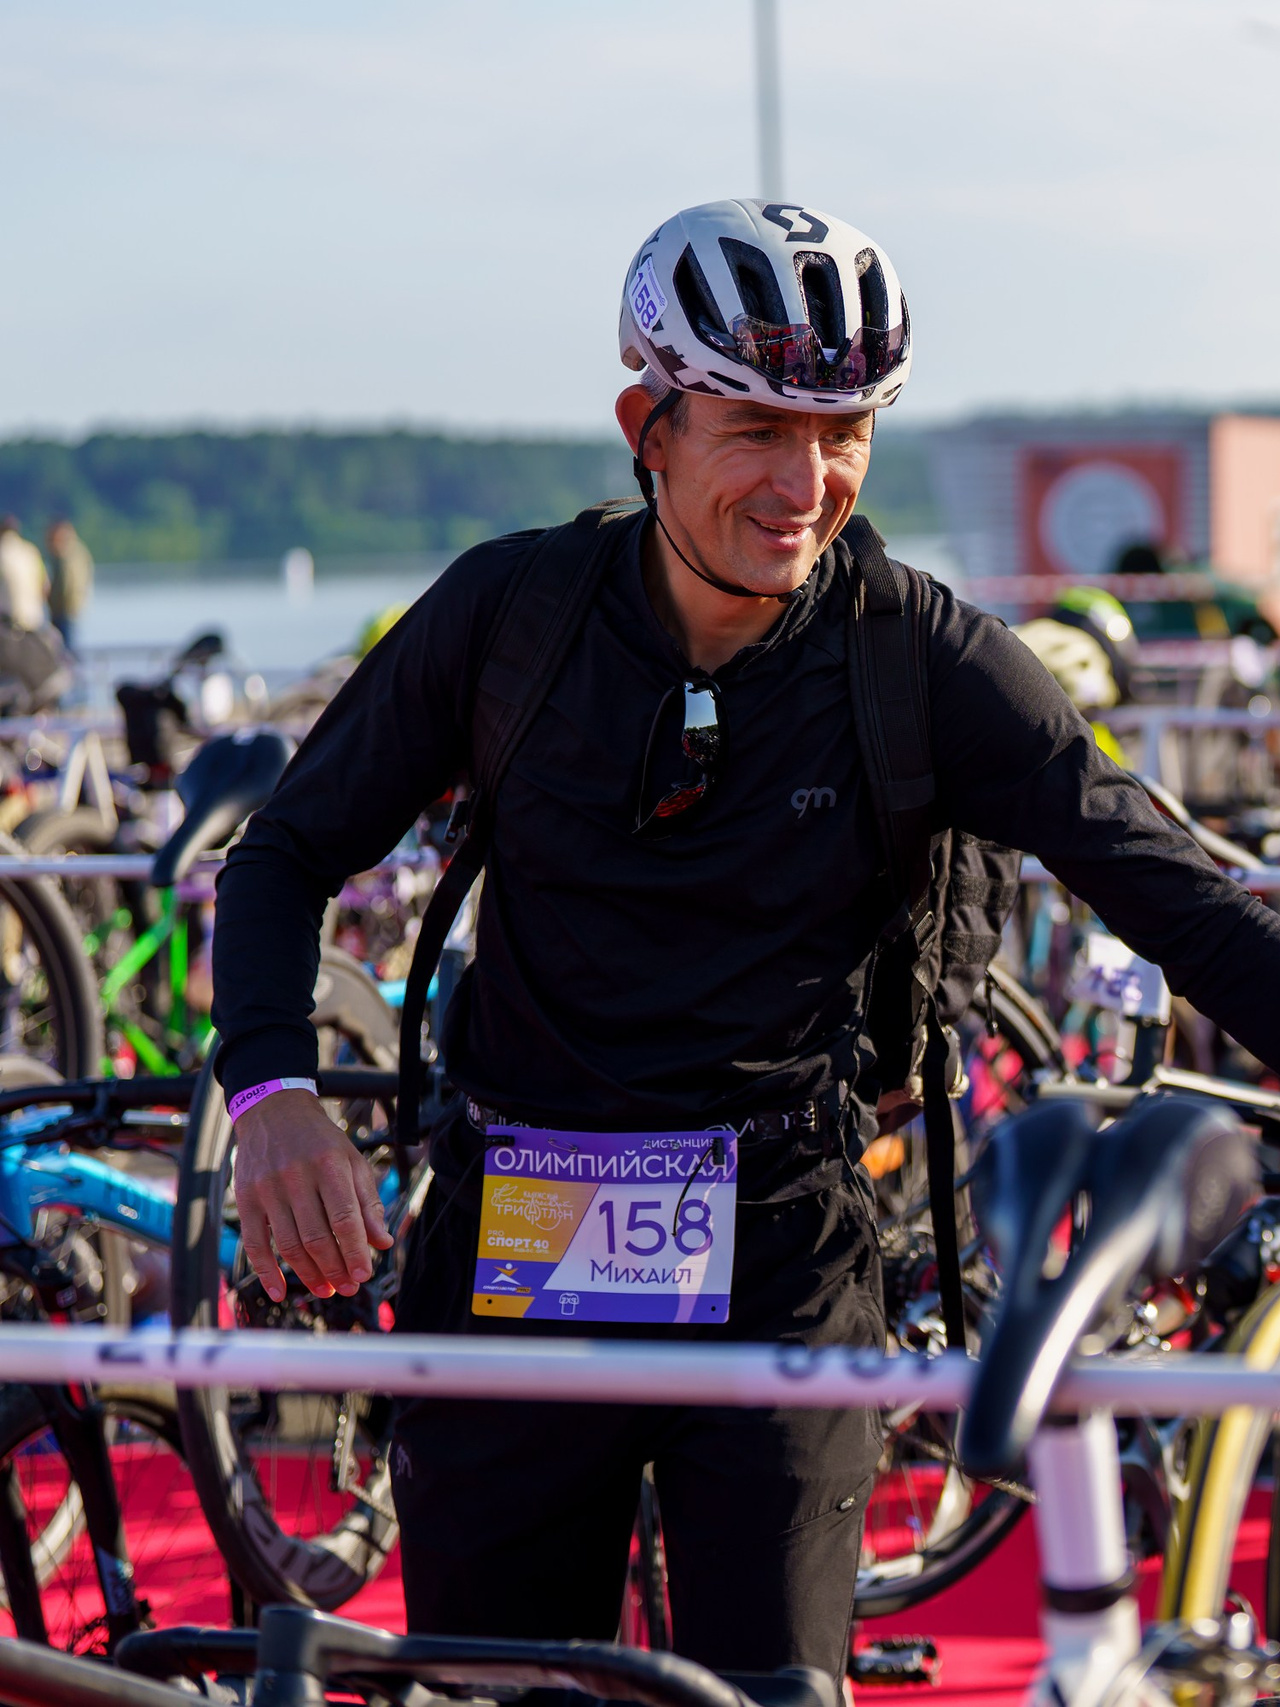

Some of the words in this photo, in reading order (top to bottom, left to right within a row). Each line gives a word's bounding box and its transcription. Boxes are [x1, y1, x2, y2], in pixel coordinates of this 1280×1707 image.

[631, 272, 658, 330] 158
[493, 1147, 728, 1178] ОЛИМПИЙСКАЯ
[487, 1237, 531, 1249] СПОРТ
[533, 1239, 550, 1250] 40
[598, 1198, 714, 1257] 158
